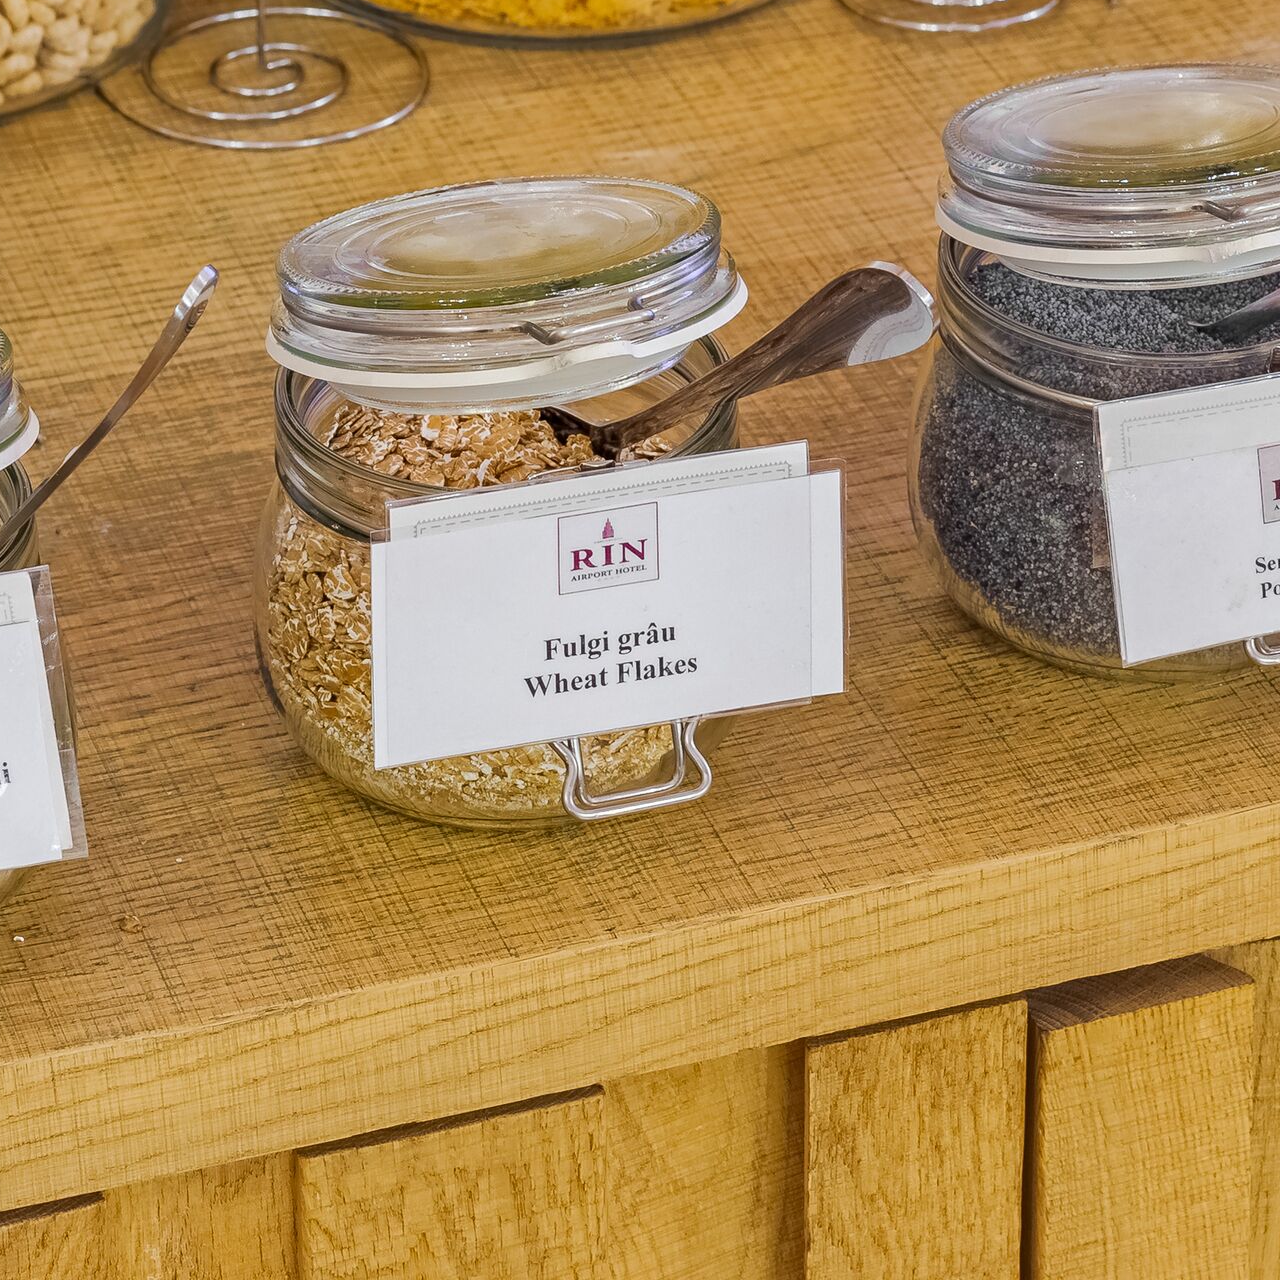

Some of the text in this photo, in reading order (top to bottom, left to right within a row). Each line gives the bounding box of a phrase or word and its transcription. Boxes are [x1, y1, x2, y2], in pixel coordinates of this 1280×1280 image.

[570, 539, 648, 571] RIN
[571, 565, 648, 582] AIRPORT HOTEL
[544, 623, 676, 661] Fulgi grâu
[524, 654, 698, 698] Wheat Flakes
